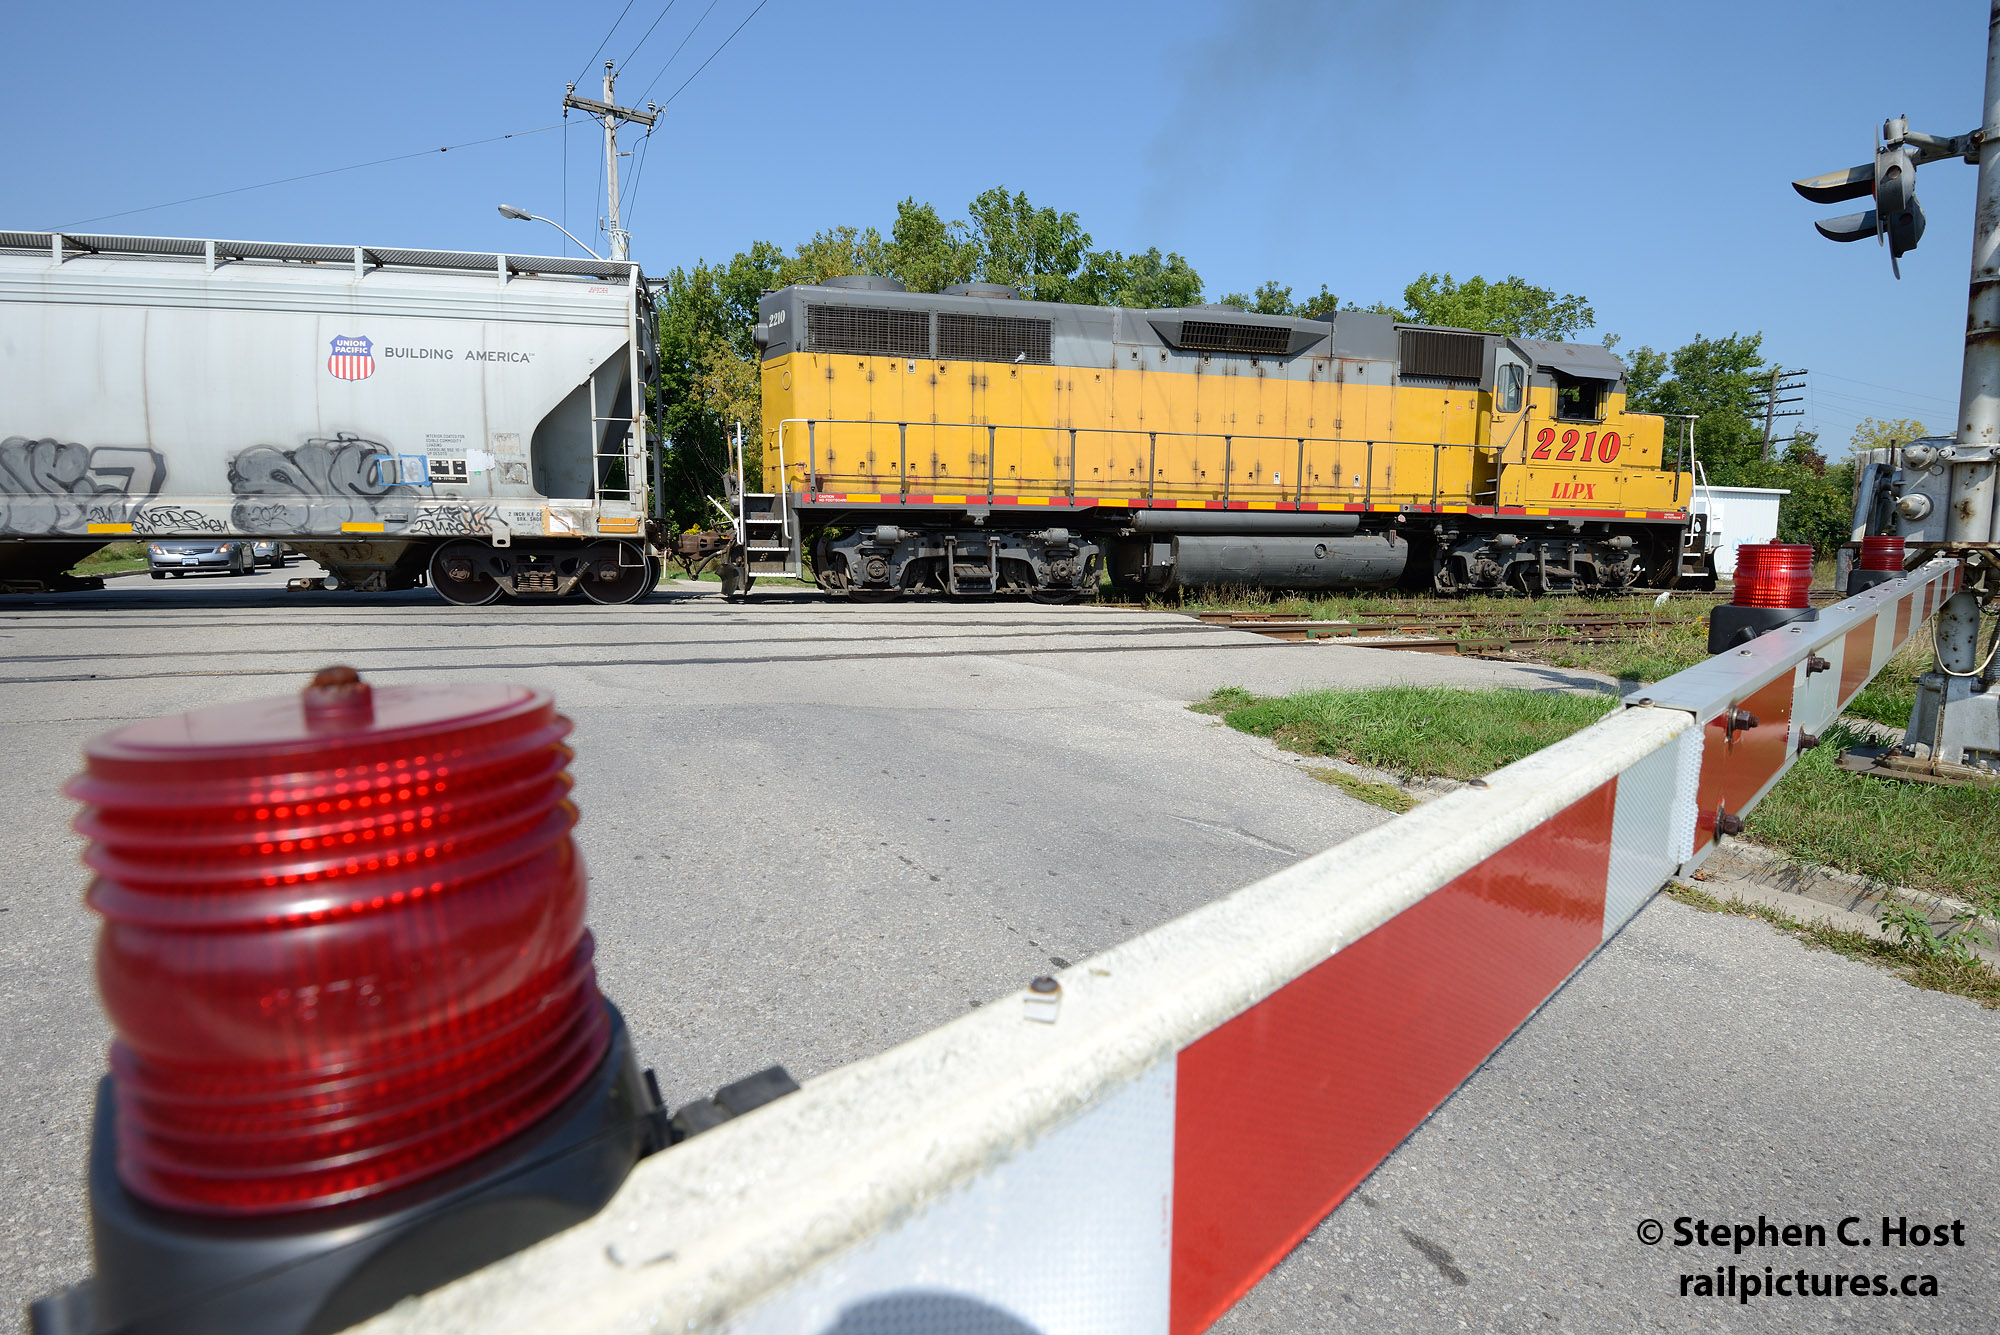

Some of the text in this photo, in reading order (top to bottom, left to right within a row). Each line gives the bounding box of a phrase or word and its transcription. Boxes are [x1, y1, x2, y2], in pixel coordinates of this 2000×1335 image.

[768, 309, 786, 328] 2210
[335, 346, 368, 354] PACIFIC
[385, 347, 454, 360] BUILDING
[1531, 427, 1621, 463] 2210
[1551, 482, 1597, 500] LLPX
